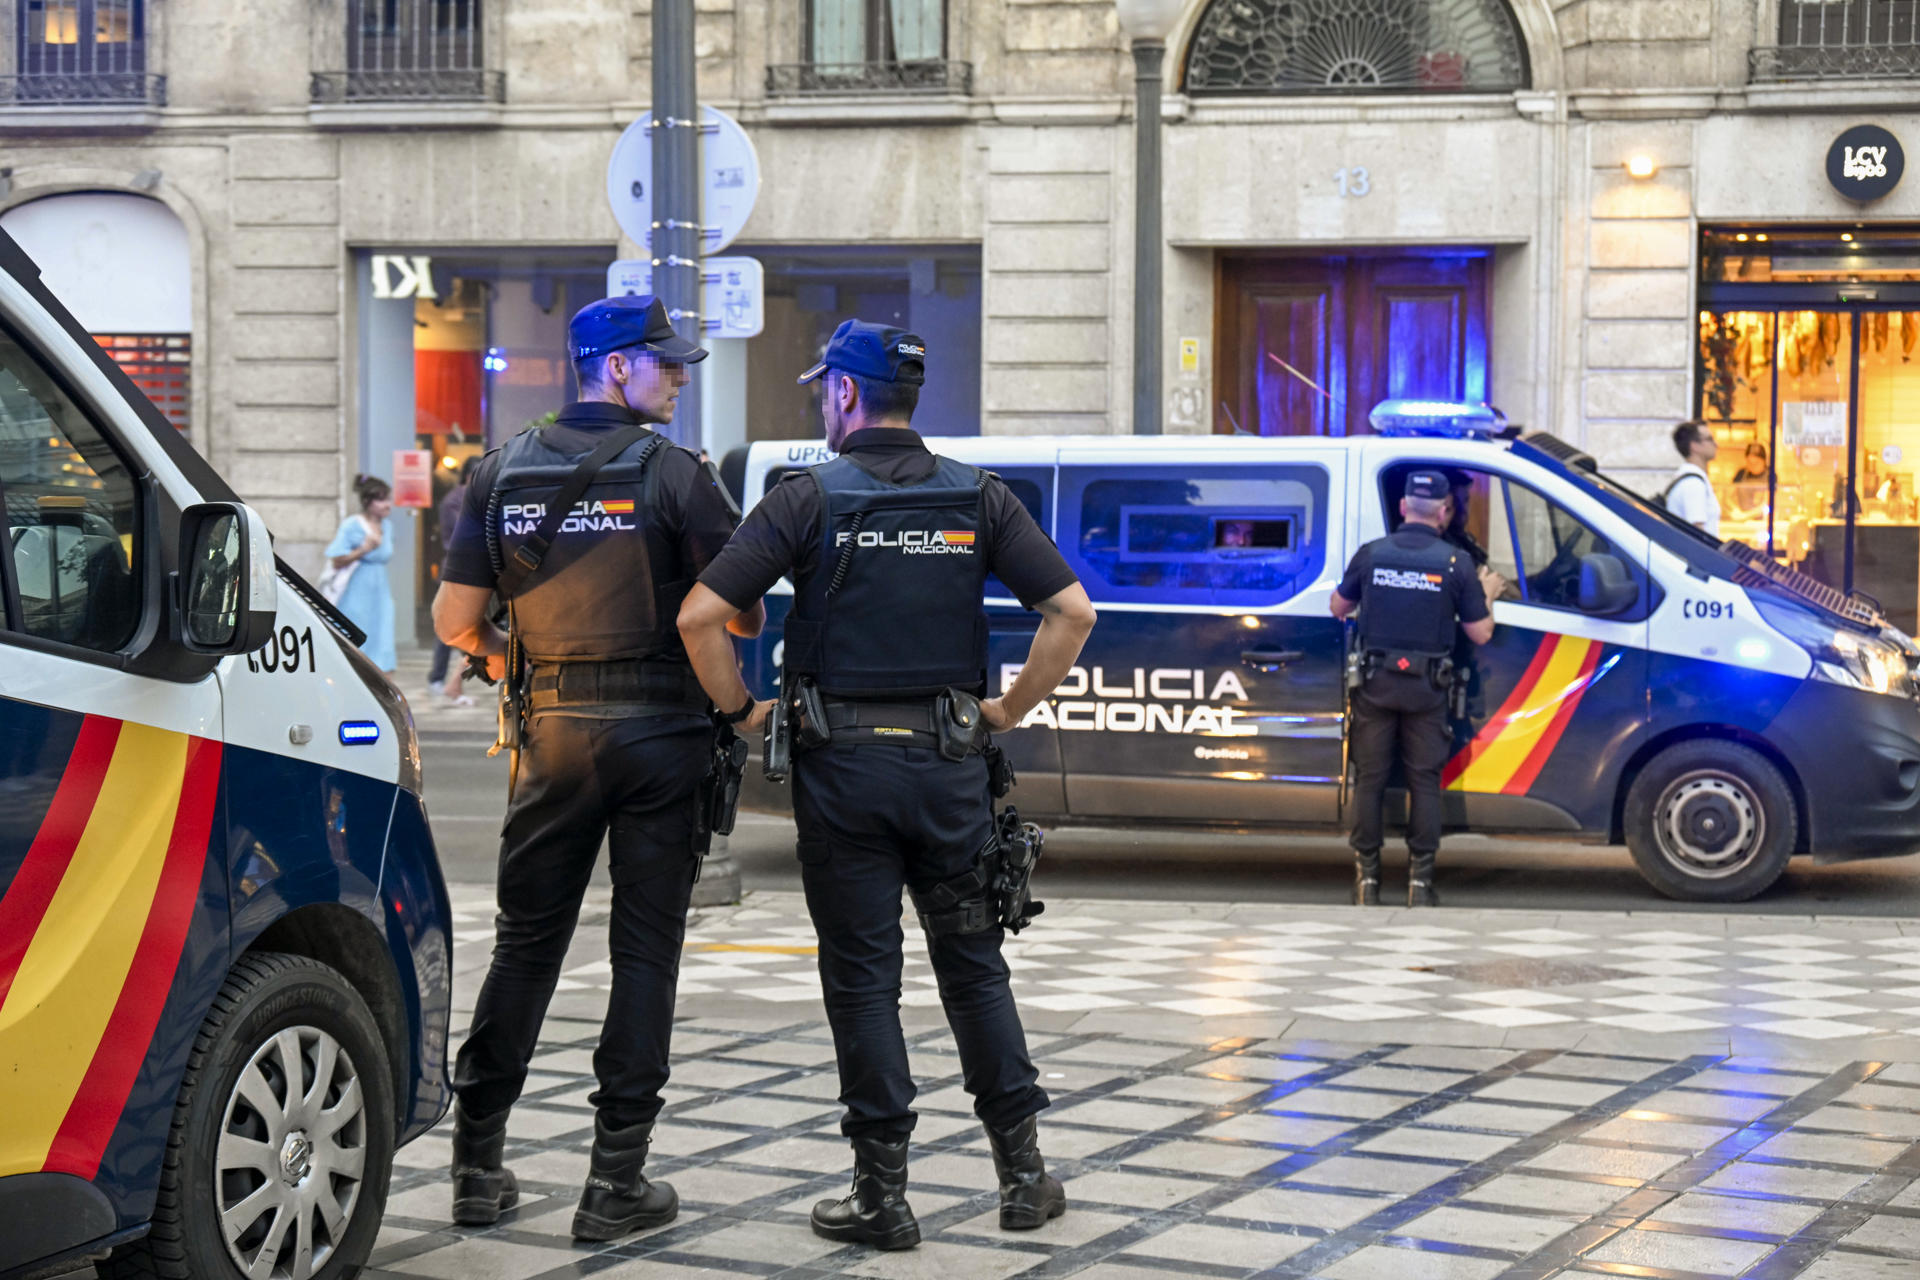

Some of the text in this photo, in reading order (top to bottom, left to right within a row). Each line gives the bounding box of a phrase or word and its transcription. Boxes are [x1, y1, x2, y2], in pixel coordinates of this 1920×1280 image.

[1333, 165, 1369, 198] 13
[504, 516, 636, 535] NAONAL
[903, 545, 974, 554] NACIONAL
[1373, 577, 1442, 592] NACIONAL
[1374, 568, 1428, 582] POLICIA
[1695, 600, 1733, 619] 091
[260, 626, 316, 673] 091
[1015, 700, 1259, 735] ACIONAL
